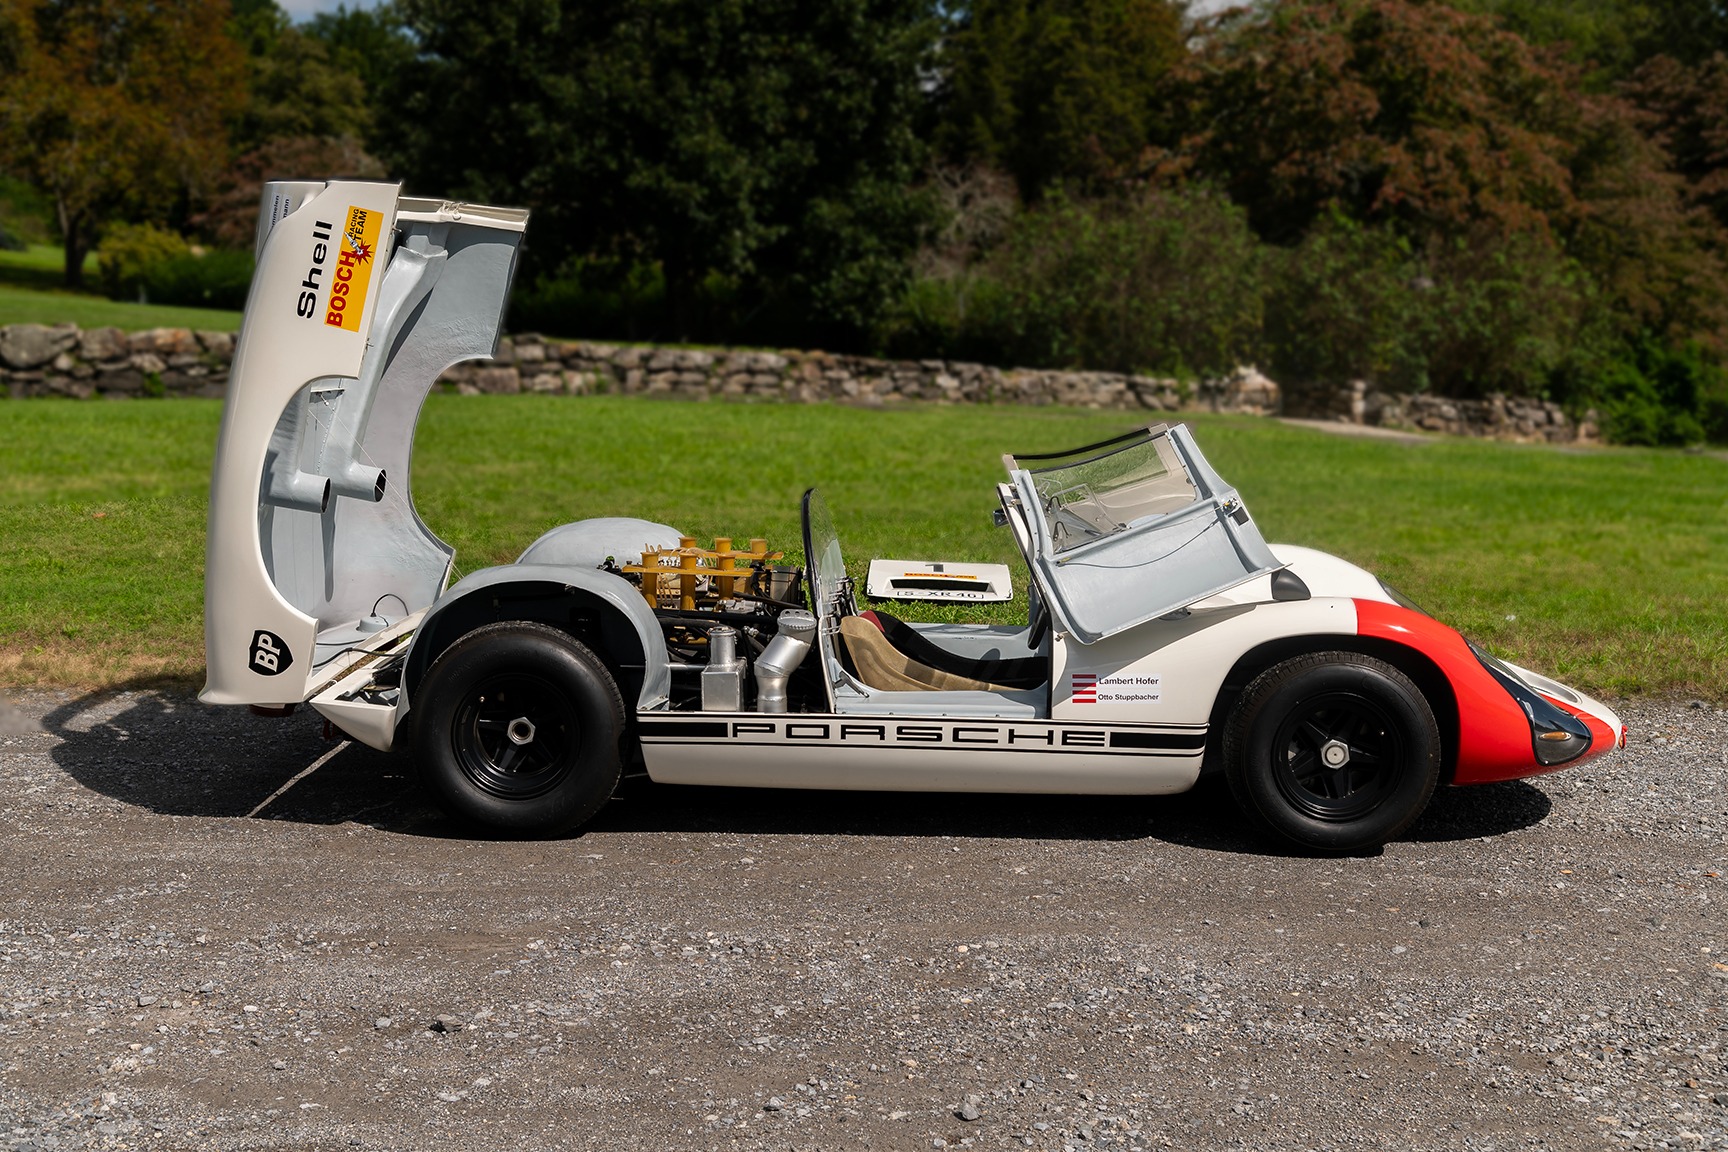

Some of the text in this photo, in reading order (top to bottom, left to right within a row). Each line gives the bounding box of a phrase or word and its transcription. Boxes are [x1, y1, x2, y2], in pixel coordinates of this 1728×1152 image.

[348, 208, 360, 238] RACING
[352, 210, 367, 241] TEAM
[297, 220, 333, 319] Shell
[326, 250, 356, 327] BOSCH
[254, 633, 280, 673] BP
[1099, 677, 1159, 685] Lambert Hofer
[732, 722, 1105, 747] PORSCHE
